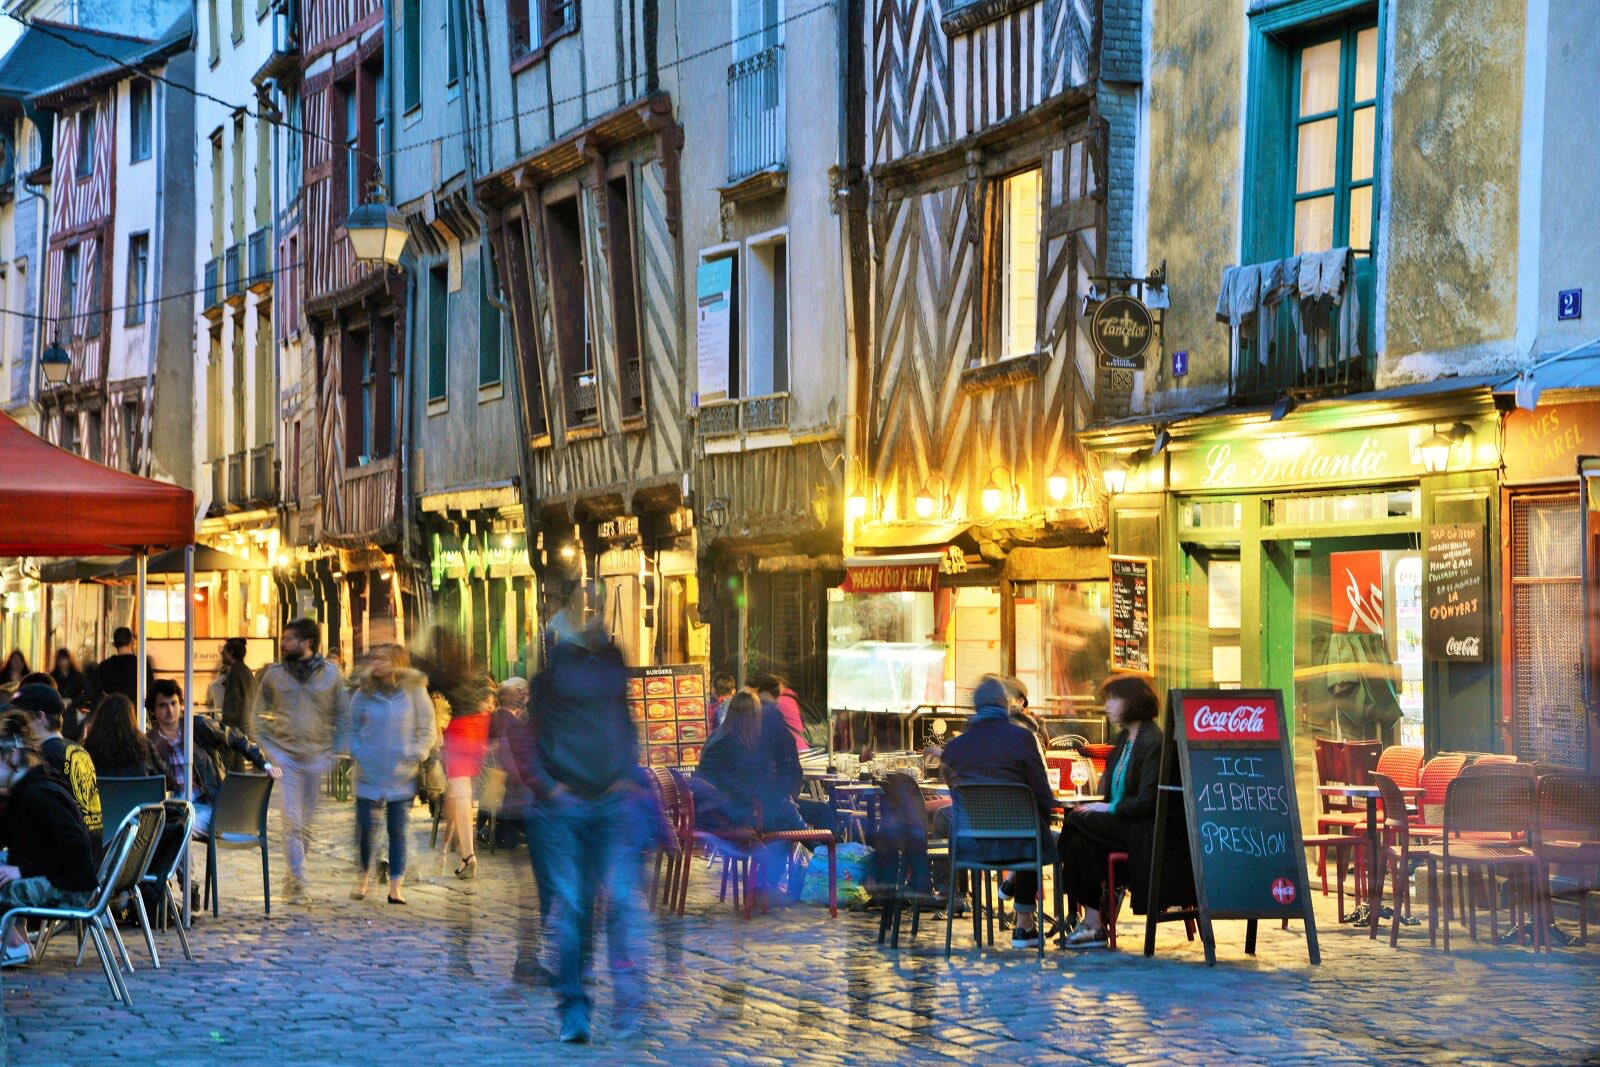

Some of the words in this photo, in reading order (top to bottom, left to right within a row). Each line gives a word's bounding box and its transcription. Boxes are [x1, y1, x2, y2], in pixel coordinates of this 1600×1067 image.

[1564, 293, 1574, 315] 2
[1520, 408, 1560, 449] YVES
[1201, 443, 1237, 486] Le
[1430, 529, 1445, 540] TAP
[1448, 590, 1459, 604] LA
[645, 668, 673, 676] BURGERS
[1193, 705, 1266, 733] Coca-Cola
[1213, 756, 1265, 778] ICI
[1199, 782, 1227, 812] 19
[1201, 821, 1286, 858] PRESSION
